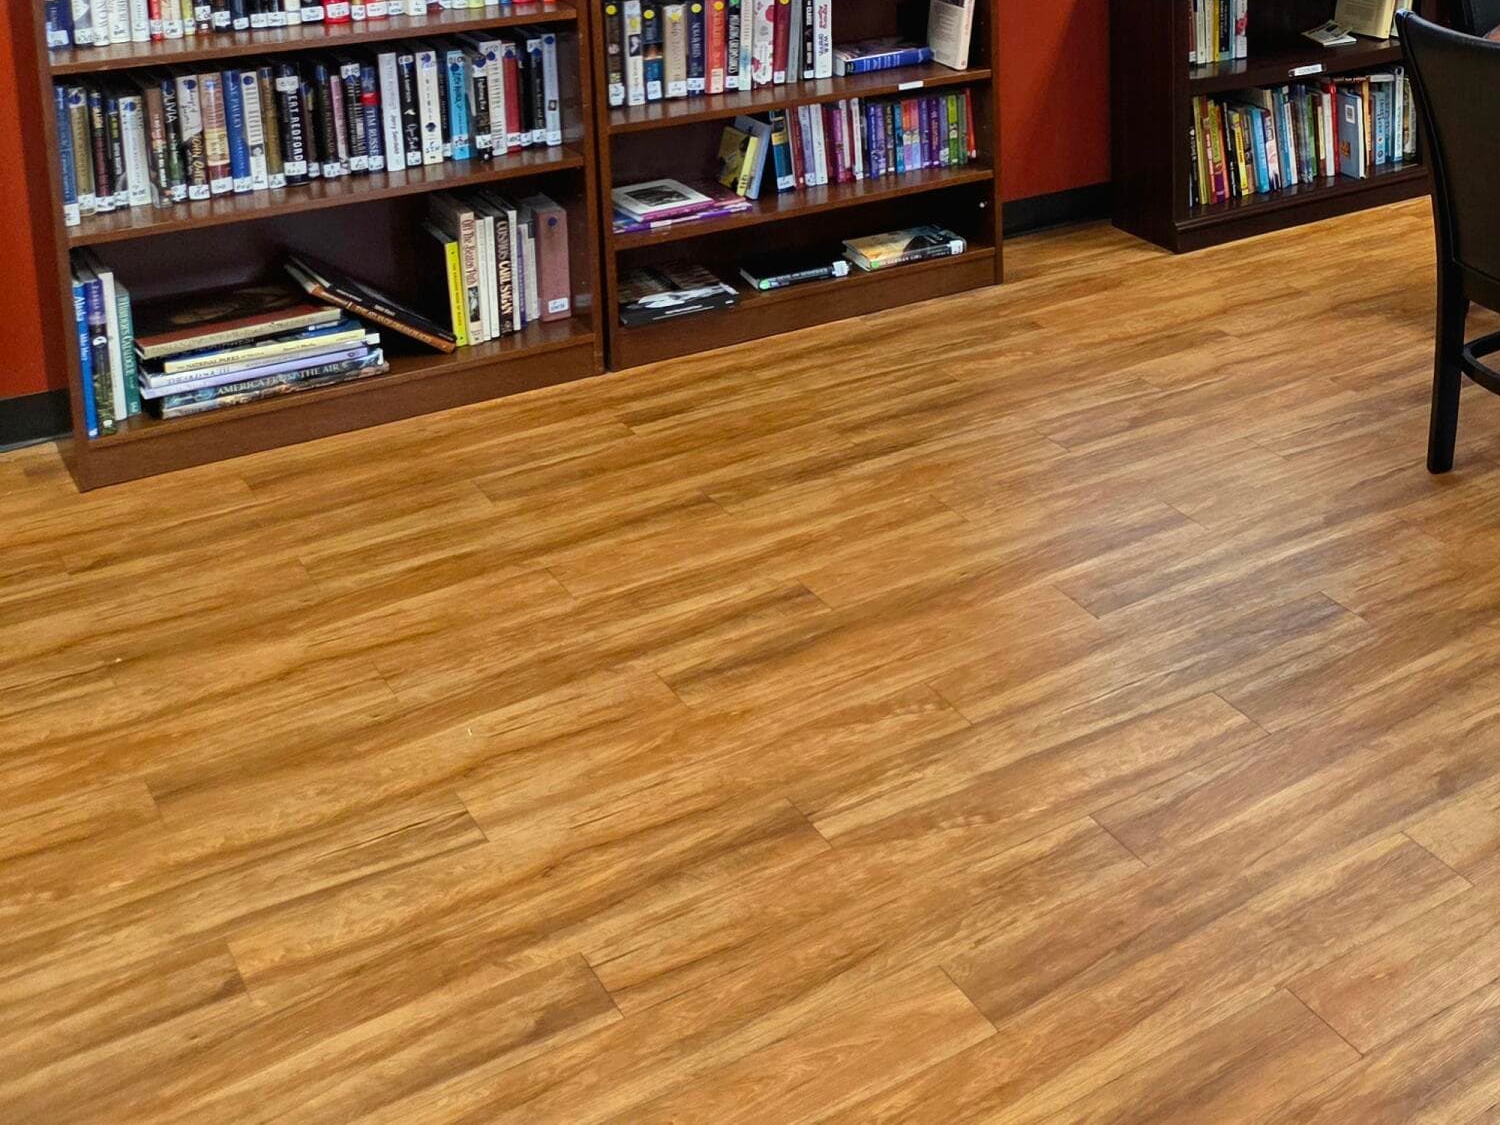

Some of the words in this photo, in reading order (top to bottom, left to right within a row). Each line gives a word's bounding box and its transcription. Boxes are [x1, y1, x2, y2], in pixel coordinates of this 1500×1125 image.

[368, 125, 378, 156] RUSSE
[498, 260, 511, 284] CARL
[216, 380, 265, 395] AMERICA
